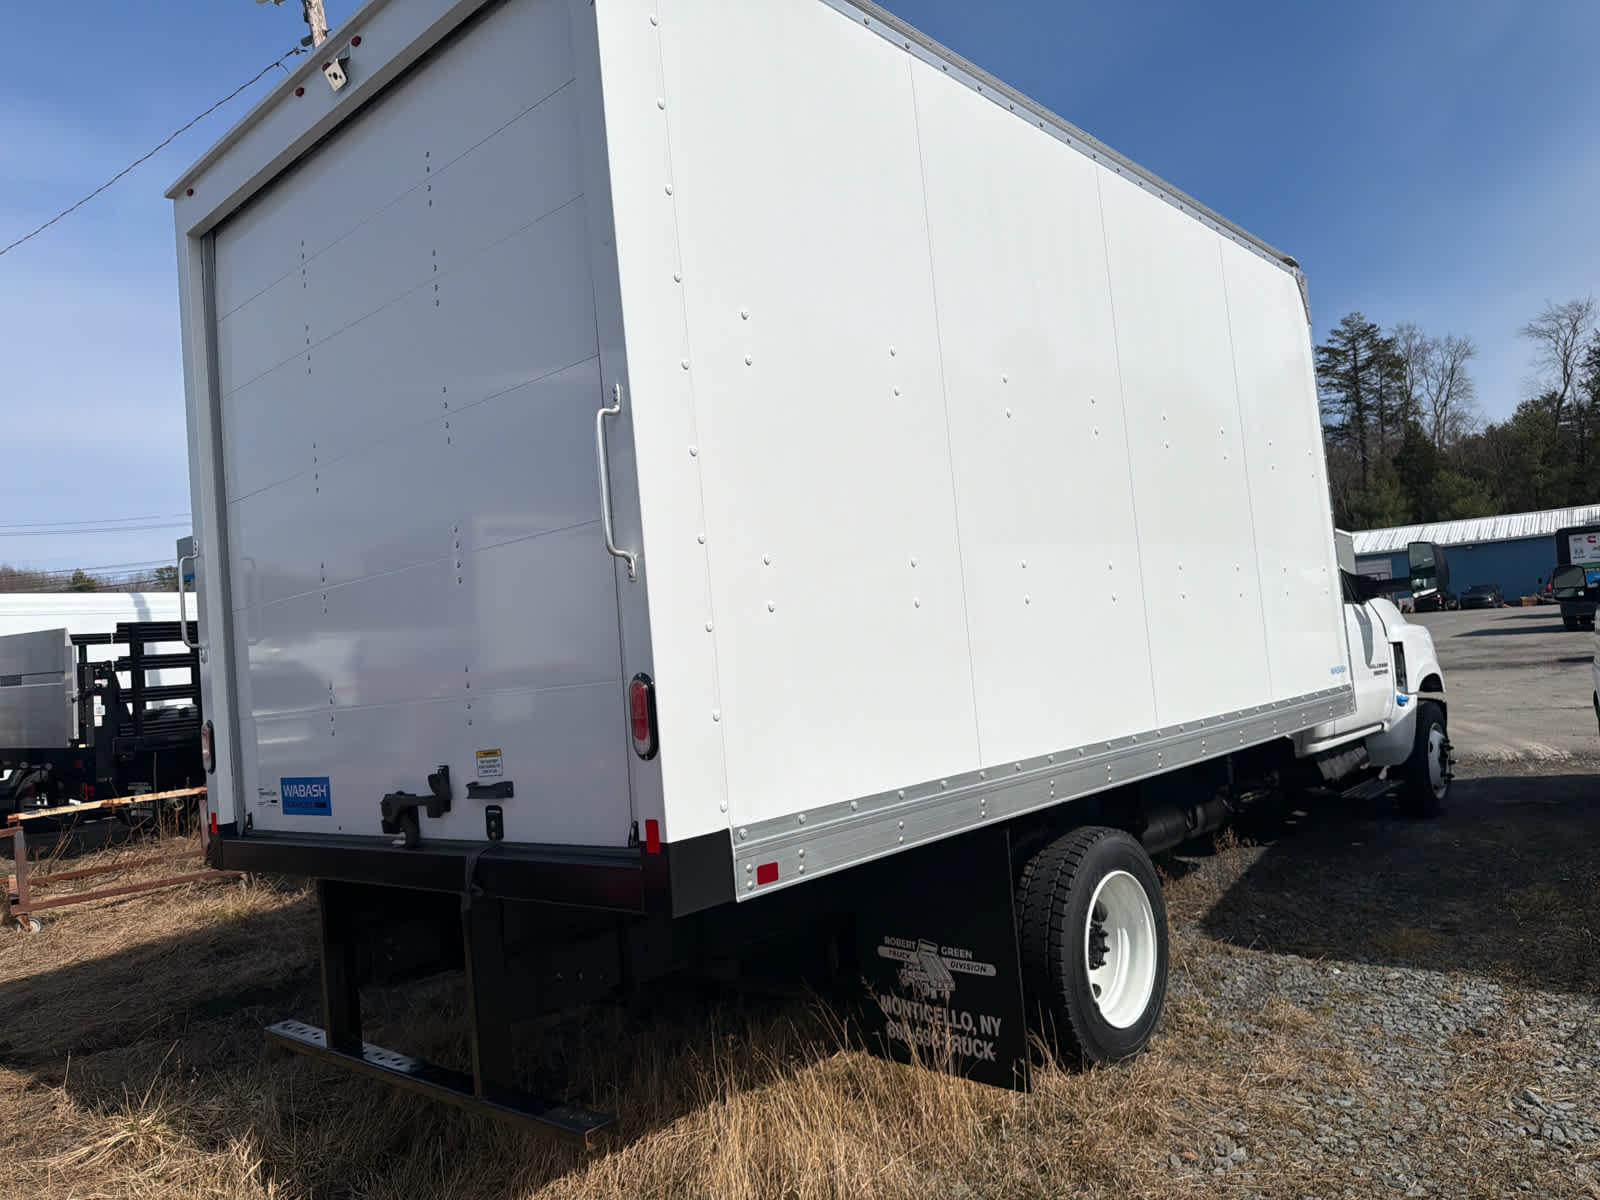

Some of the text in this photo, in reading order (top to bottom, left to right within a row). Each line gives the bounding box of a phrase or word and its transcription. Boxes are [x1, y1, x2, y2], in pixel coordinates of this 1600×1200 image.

[282, 783, 328, 799] WABASH
[884, 935, 973, 960] ROBERT GREEN
[888, 949, 987, 974] TRUCK DIVISION
[979, 1014, 1002, 1038] NY
